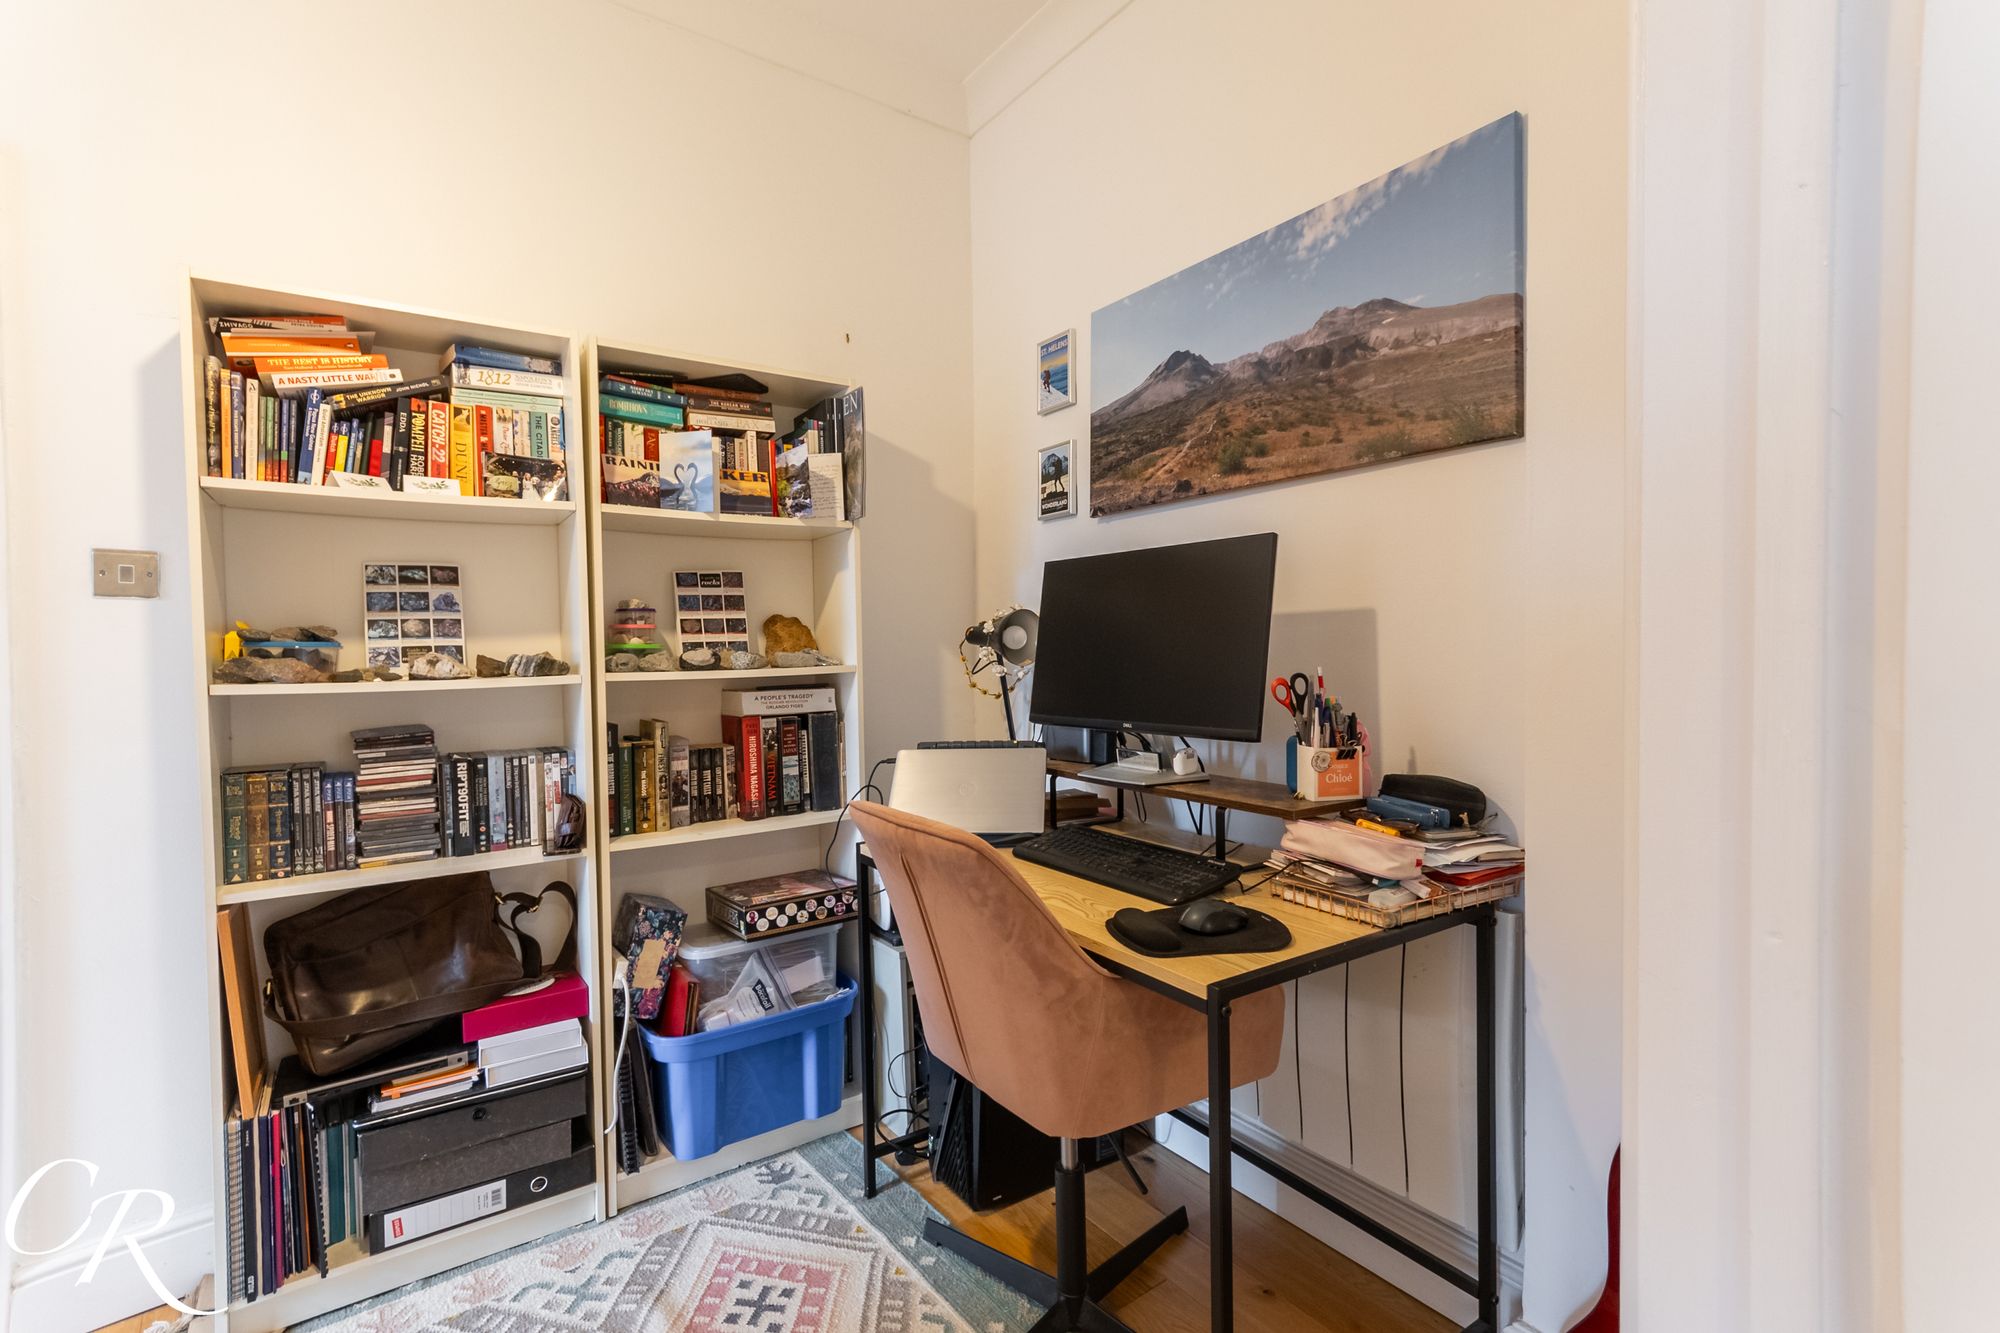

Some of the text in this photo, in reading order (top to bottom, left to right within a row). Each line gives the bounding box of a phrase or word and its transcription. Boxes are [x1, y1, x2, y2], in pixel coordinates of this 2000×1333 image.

[332, 356, 373, 364] HISTORY
[287, 376, 319, 384] NASTY
[322, 374, 354, 382] LITTLE
[355, 373, 378, 382] WAR
[477, 369, 512, 385] 1812
[356, 394, 386, 403] WARRIOR
[359, 387, 392, 398] UNKNOWN
[399, 412, 407, 432] EDDA
[411, 412, 426, 452] POMPEII
[432, 409, 446, 464] CATCH-22
[308, 434, 316, 450] Guinea
[330, 436, 338, 452] Dutch
[1042, 498, 1068, 509] WONDERLAND
[749, 736, 758, 774] HIROSHIMA
[767, 752, 776, 799] VIETNAM
[1326, 772, 1352, 784] Chloé
[622, 764, 632, 804] PENITENT
